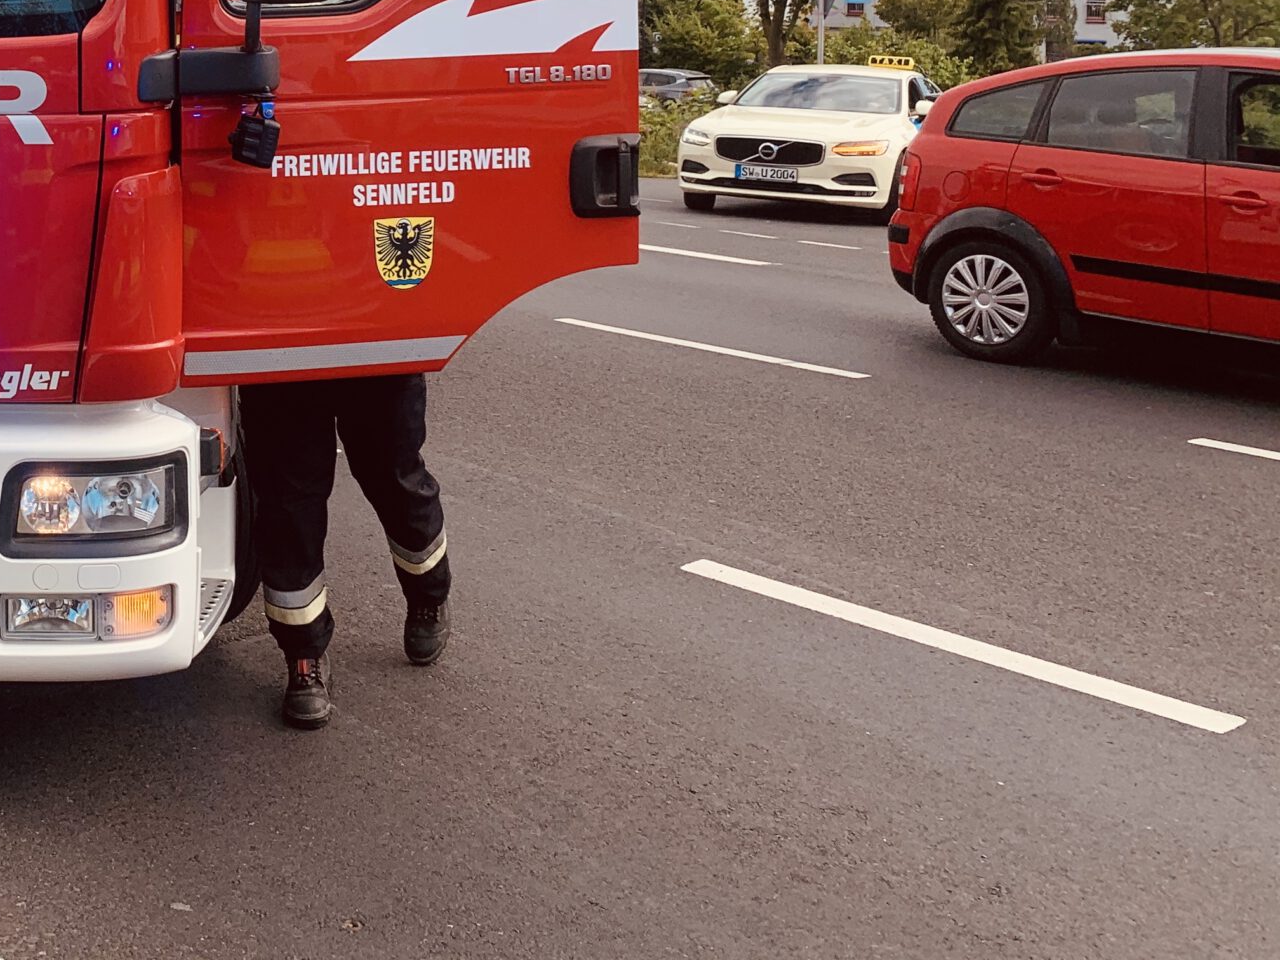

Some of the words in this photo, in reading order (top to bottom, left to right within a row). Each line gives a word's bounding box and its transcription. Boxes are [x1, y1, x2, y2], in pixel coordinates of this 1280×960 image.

[505, 66, 547, 84] TGL
[549, 63, 612, 82] 8.180
[271, 151, 402, 177] FREIWILLIGE
[409, 147, 531, 173] FEUERWEHR
[741, 166, 754, 177] SW
[761, 168, 768, 178] U
[770, 168, 795, 180] 2004
[353, 181, 455, 207] SENNFELD
